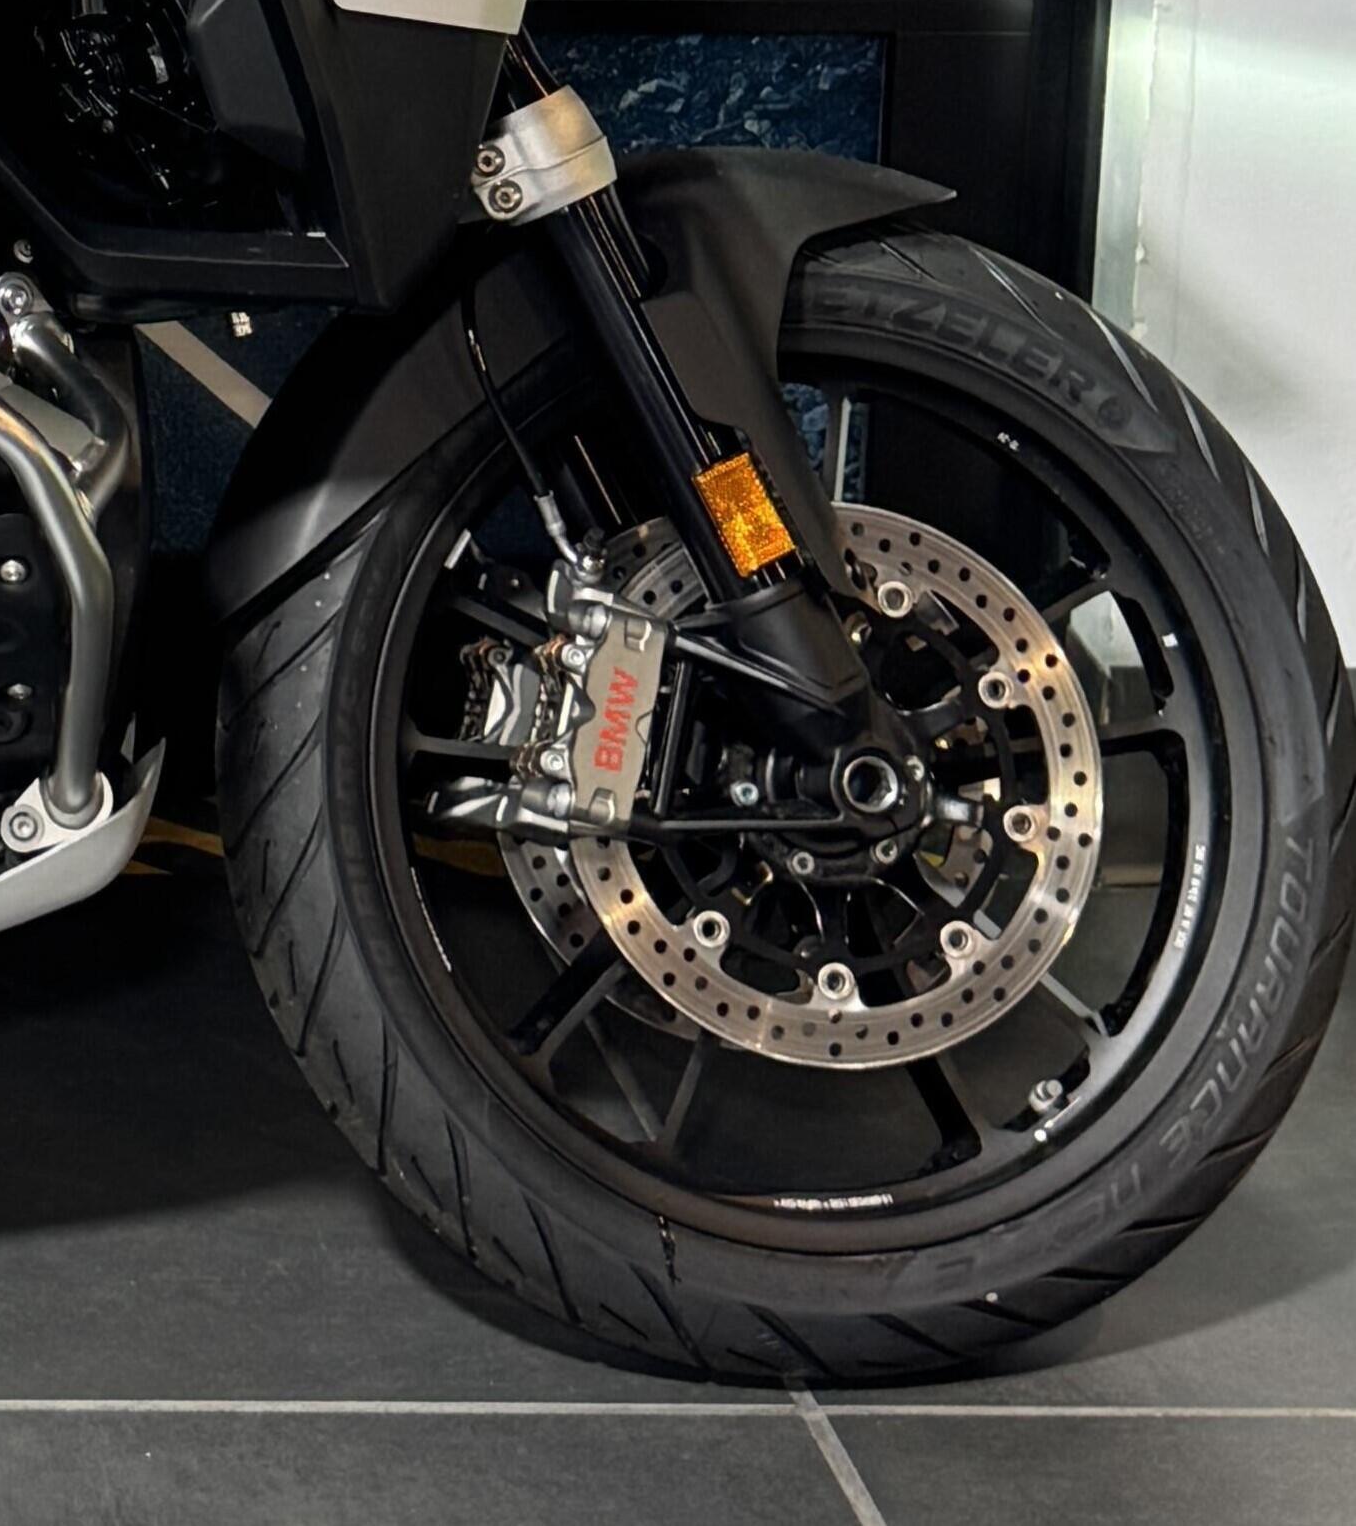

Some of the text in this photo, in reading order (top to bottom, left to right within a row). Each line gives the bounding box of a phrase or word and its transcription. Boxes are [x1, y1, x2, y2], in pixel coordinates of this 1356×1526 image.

[799, 280, 1097, 408] ETZELER
[593, 665, 639, 773] BMW
[1158, 836, 1316, 1170] TOURANCE
